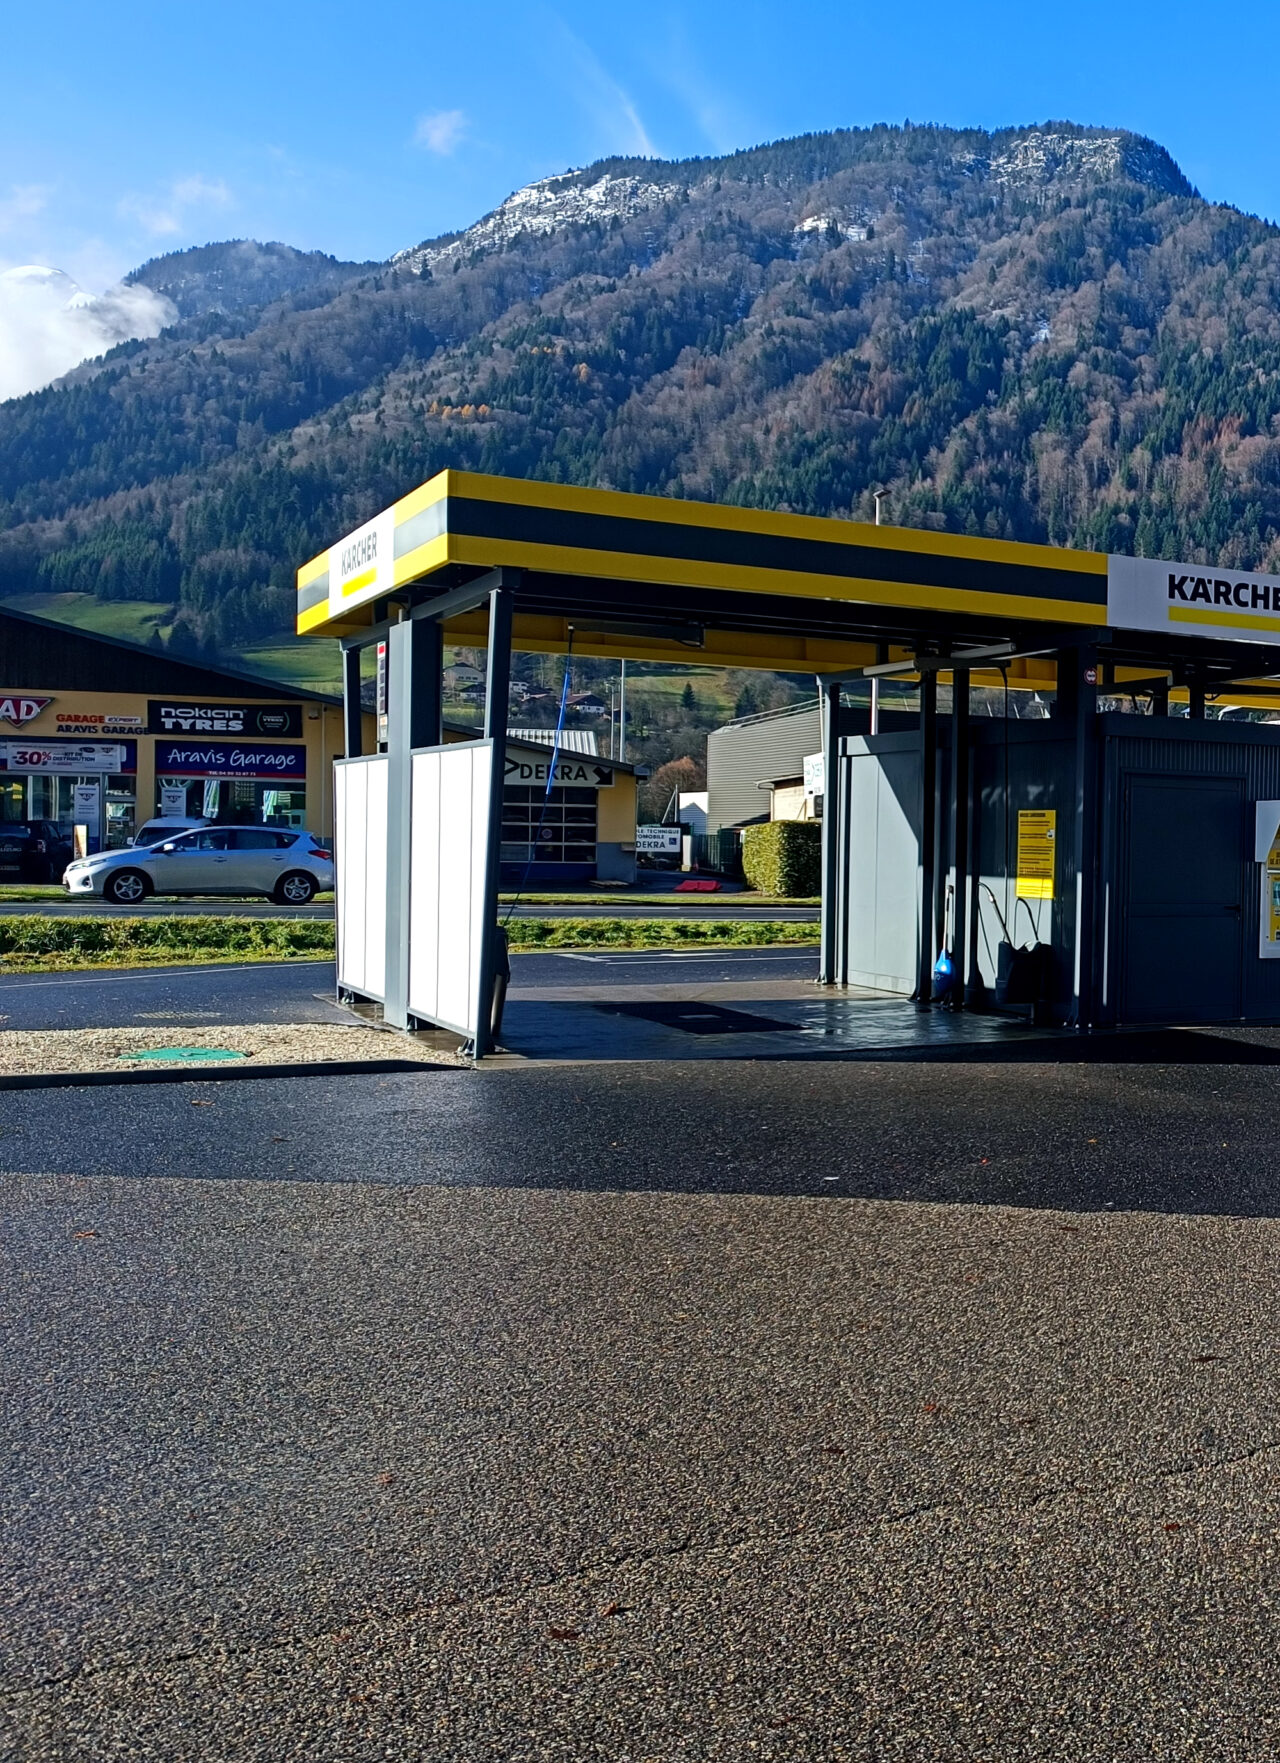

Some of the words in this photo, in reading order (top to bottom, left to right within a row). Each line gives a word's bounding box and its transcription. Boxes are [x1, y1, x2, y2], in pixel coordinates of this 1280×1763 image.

[0, 700, 40, 720] AD
[56, 714, 105, 724] GARAGE
[160, 718, 244, 731] TYRES
[56, 725, 98, 734] ARAVIS
[101, 726, 151, 735] GARAGE
[167, 749, 225, 764] Aravis
[230, 750, 296, 769] Garage
[520, 764, 588, 781] DEKRA
[635, 841, 666, 849] DEKRA
